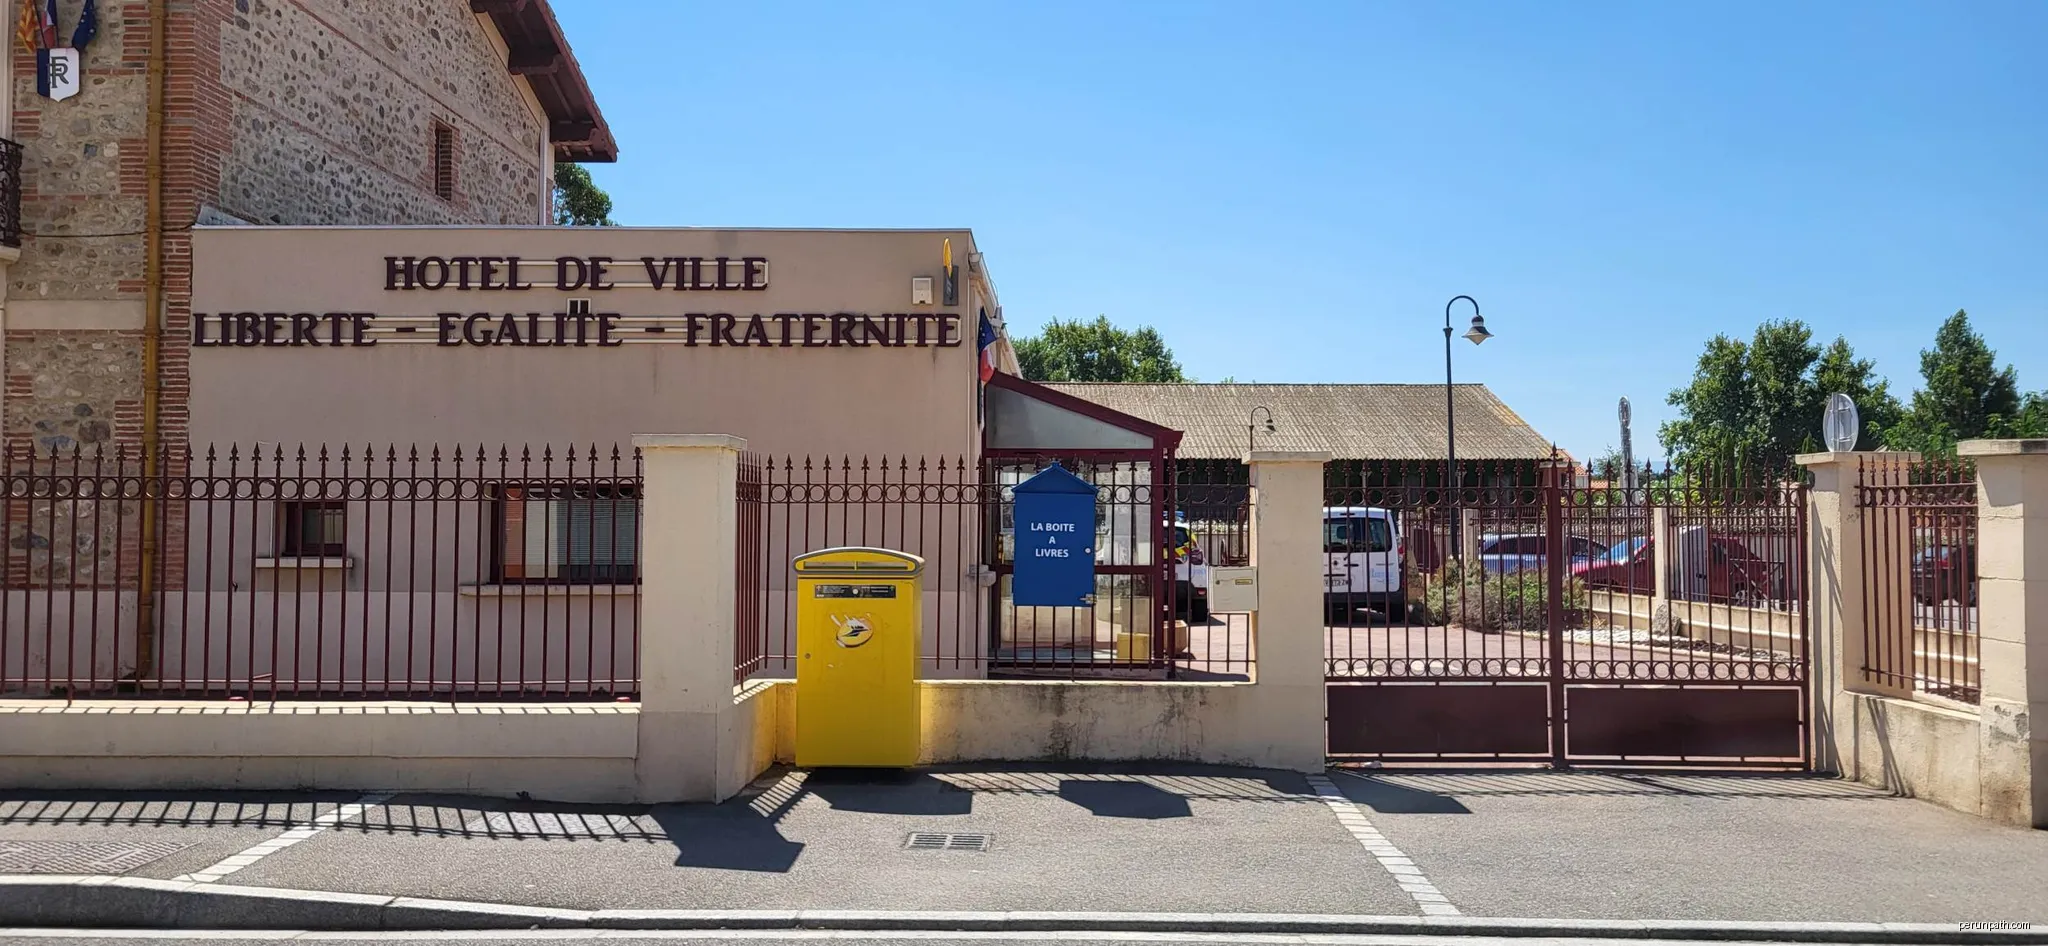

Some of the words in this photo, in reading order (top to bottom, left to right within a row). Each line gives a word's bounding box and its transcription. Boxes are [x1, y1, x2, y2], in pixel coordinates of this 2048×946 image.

[384, 256, 531, 291] HOTEL
[556, 256, 614, 291] DE
[641, 256, 768, 291] VILLE
[193, 312, 377, 347] LIBERTE
[437, 312, 623, 347] EGALITE
[684, 313, 962, 347] FRATERNITE
[1031, 522, 1044, 532] LA
[1045, 522, 1075, 532] BOITE
[1048, 535, 1056, 545] A
[1035, 548, 1069, 558] LIVRES
